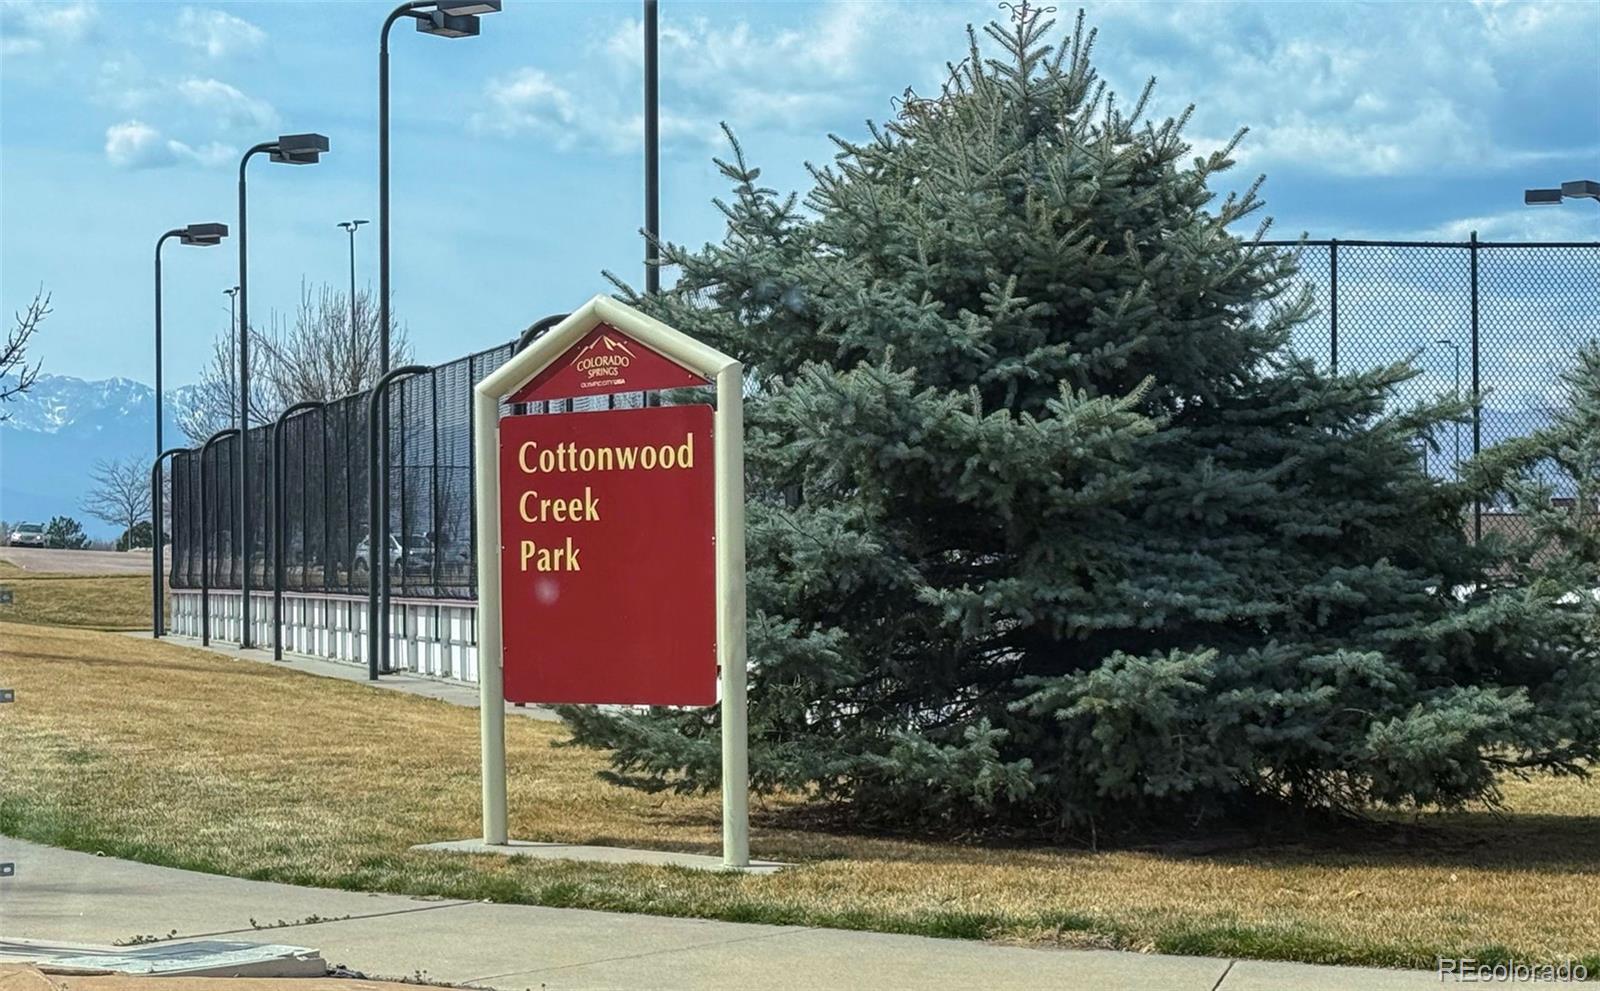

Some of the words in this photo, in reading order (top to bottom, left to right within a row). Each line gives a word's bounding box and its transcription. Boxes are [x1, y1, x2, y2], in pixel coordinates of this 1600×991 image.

[576, 355, 630, 372] COLORADO
[588, 366, 619, 379] SPRINGS
[518, 432, 694, 474] Cottonwood
[519, 486, 600, 523] Creek
[520, 536, 581, 572] Park
